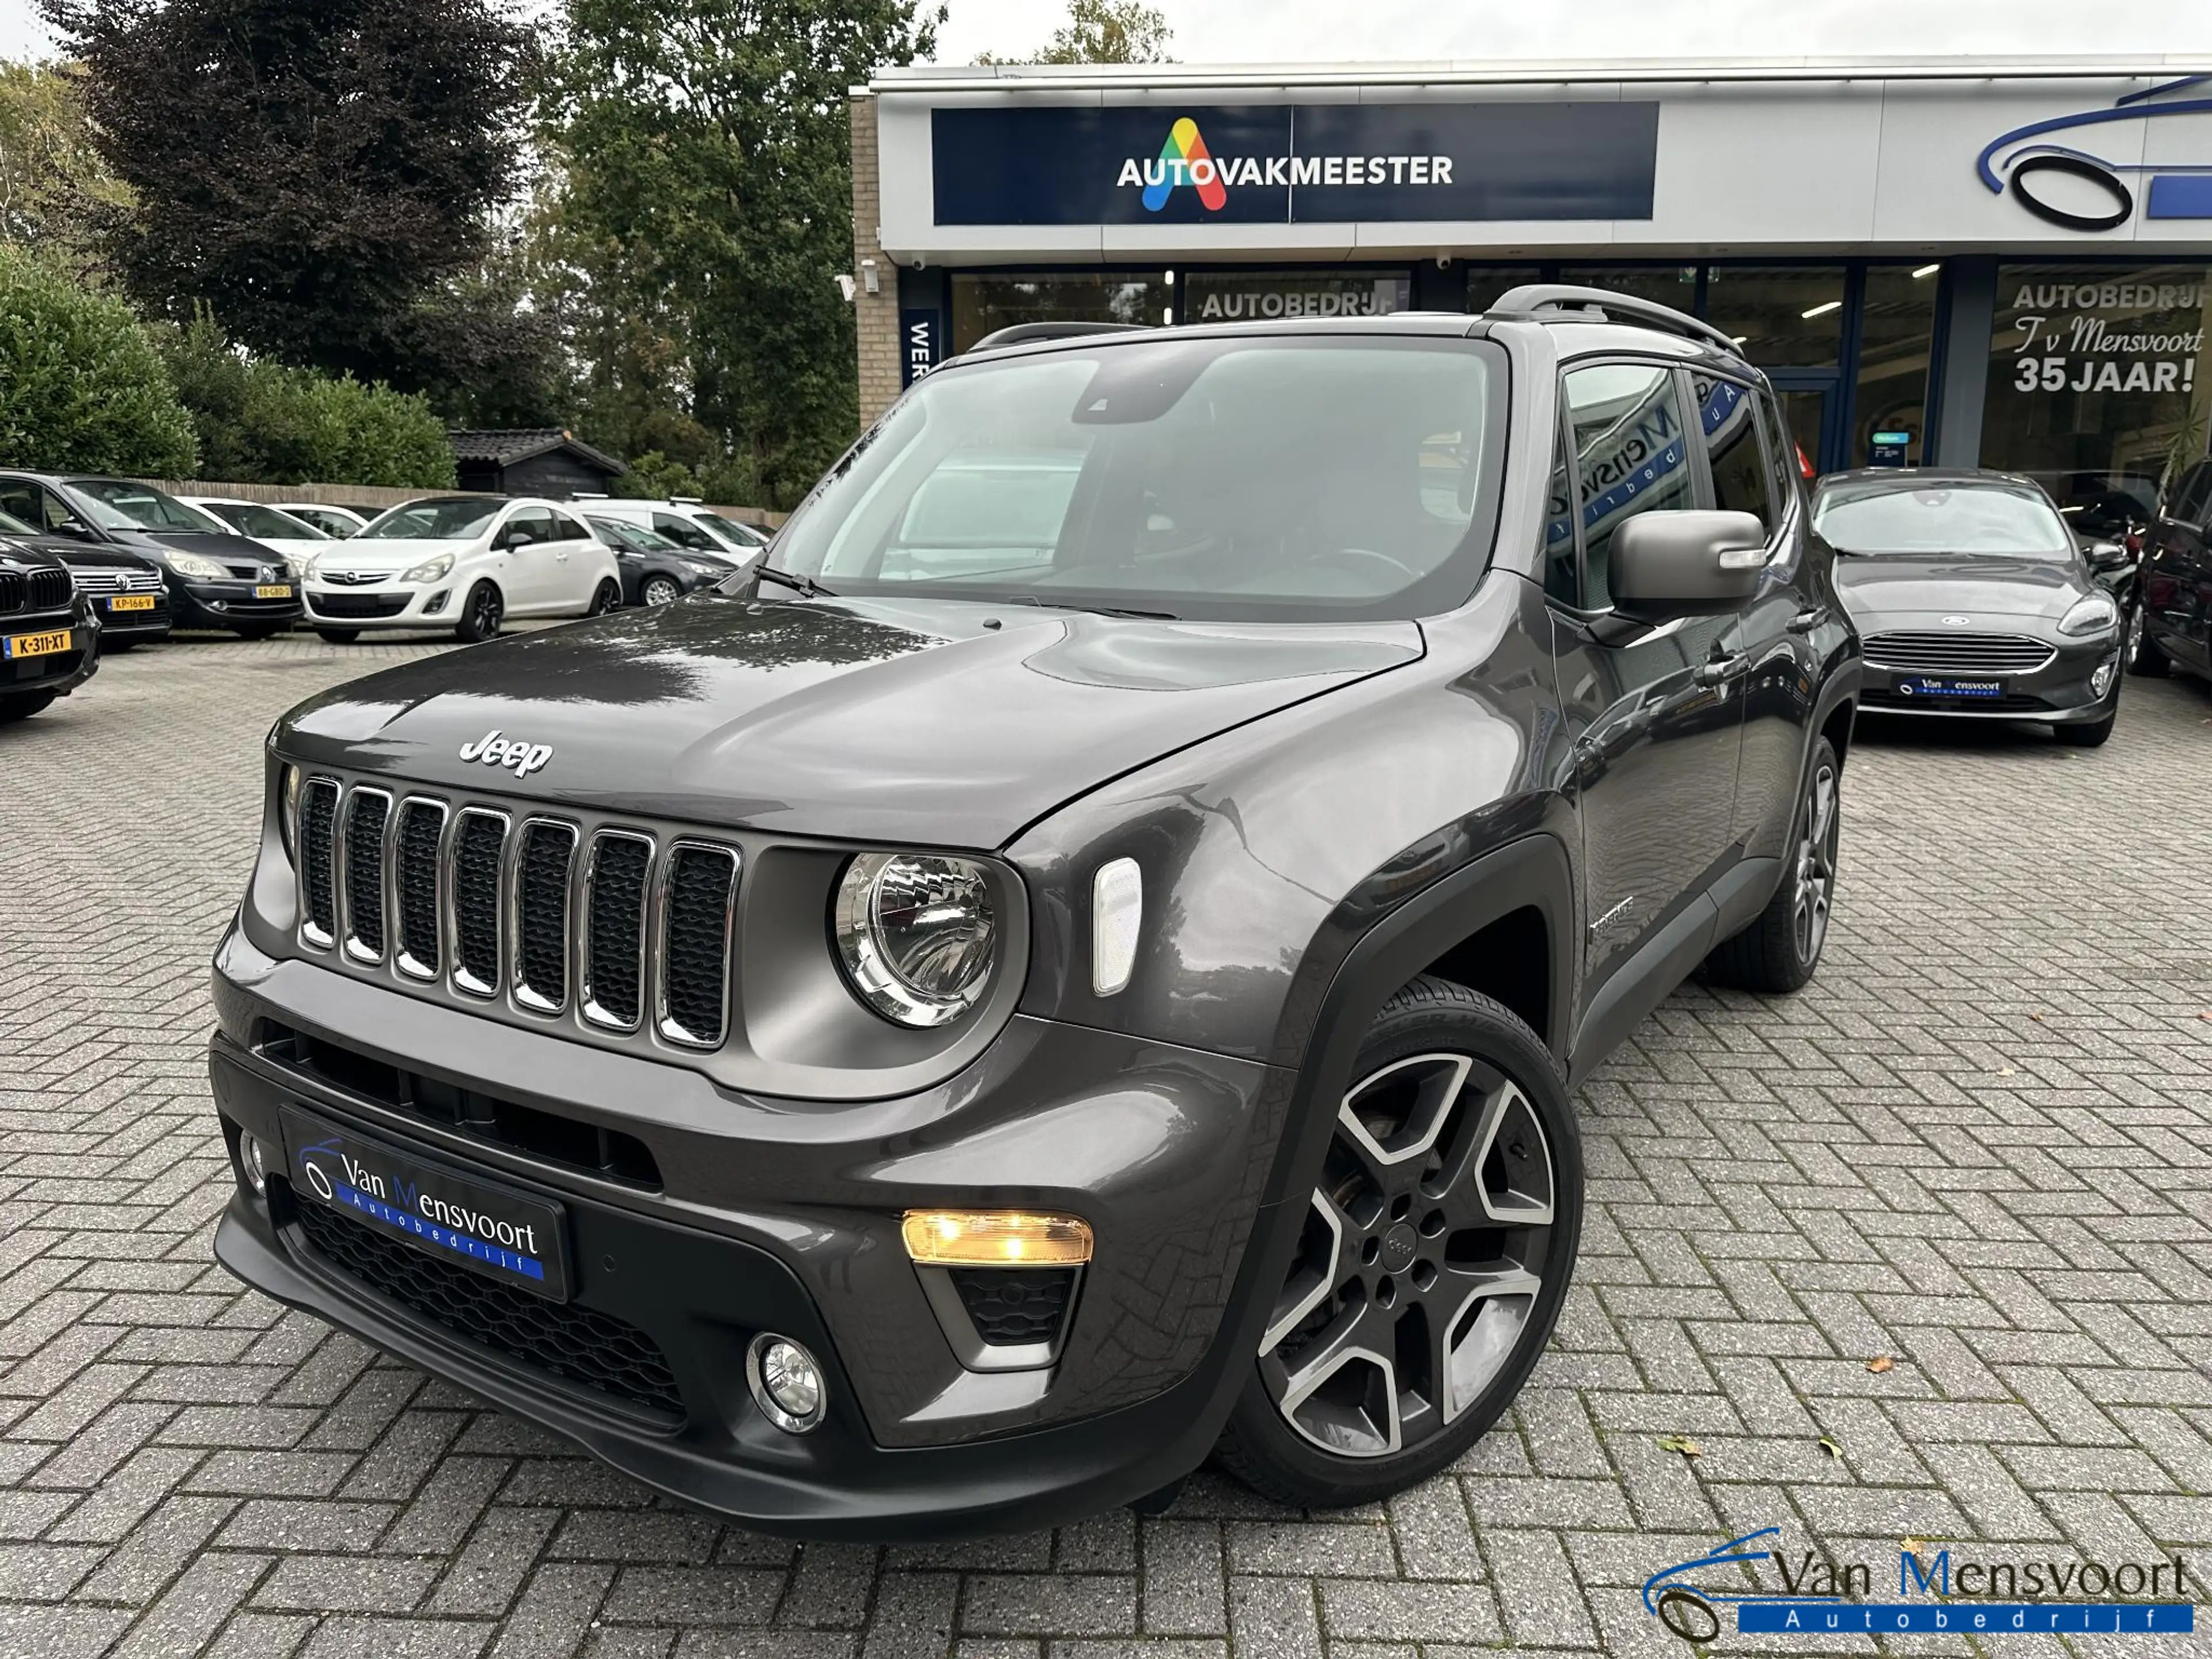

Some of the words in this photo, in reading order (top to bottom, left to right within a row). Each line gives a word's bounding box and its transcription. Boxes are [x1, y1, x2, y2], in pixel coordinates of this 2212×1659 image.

[1117, 156, 1453, 187] AUTOVAKMEESTER
[911, 321, 930, 384] WER
[2014, 316, 2046, 353] T
[2070, 315, 2205, 353] Mensvoort
[2014, 357, 2066, 392] 35
[2070, 358, 2195, 392] JAAR!
[115, 598, 151, 609] KP-166-V
[20, 634, 65, 654] K-311-XT
[459, 729, 554, 779] Jeep
[340, 1153, 386, 1199] Van
[393, 1175, 538, 1254] Mensvoort
[353, 1192, 523, 1270] Autobedrijf
